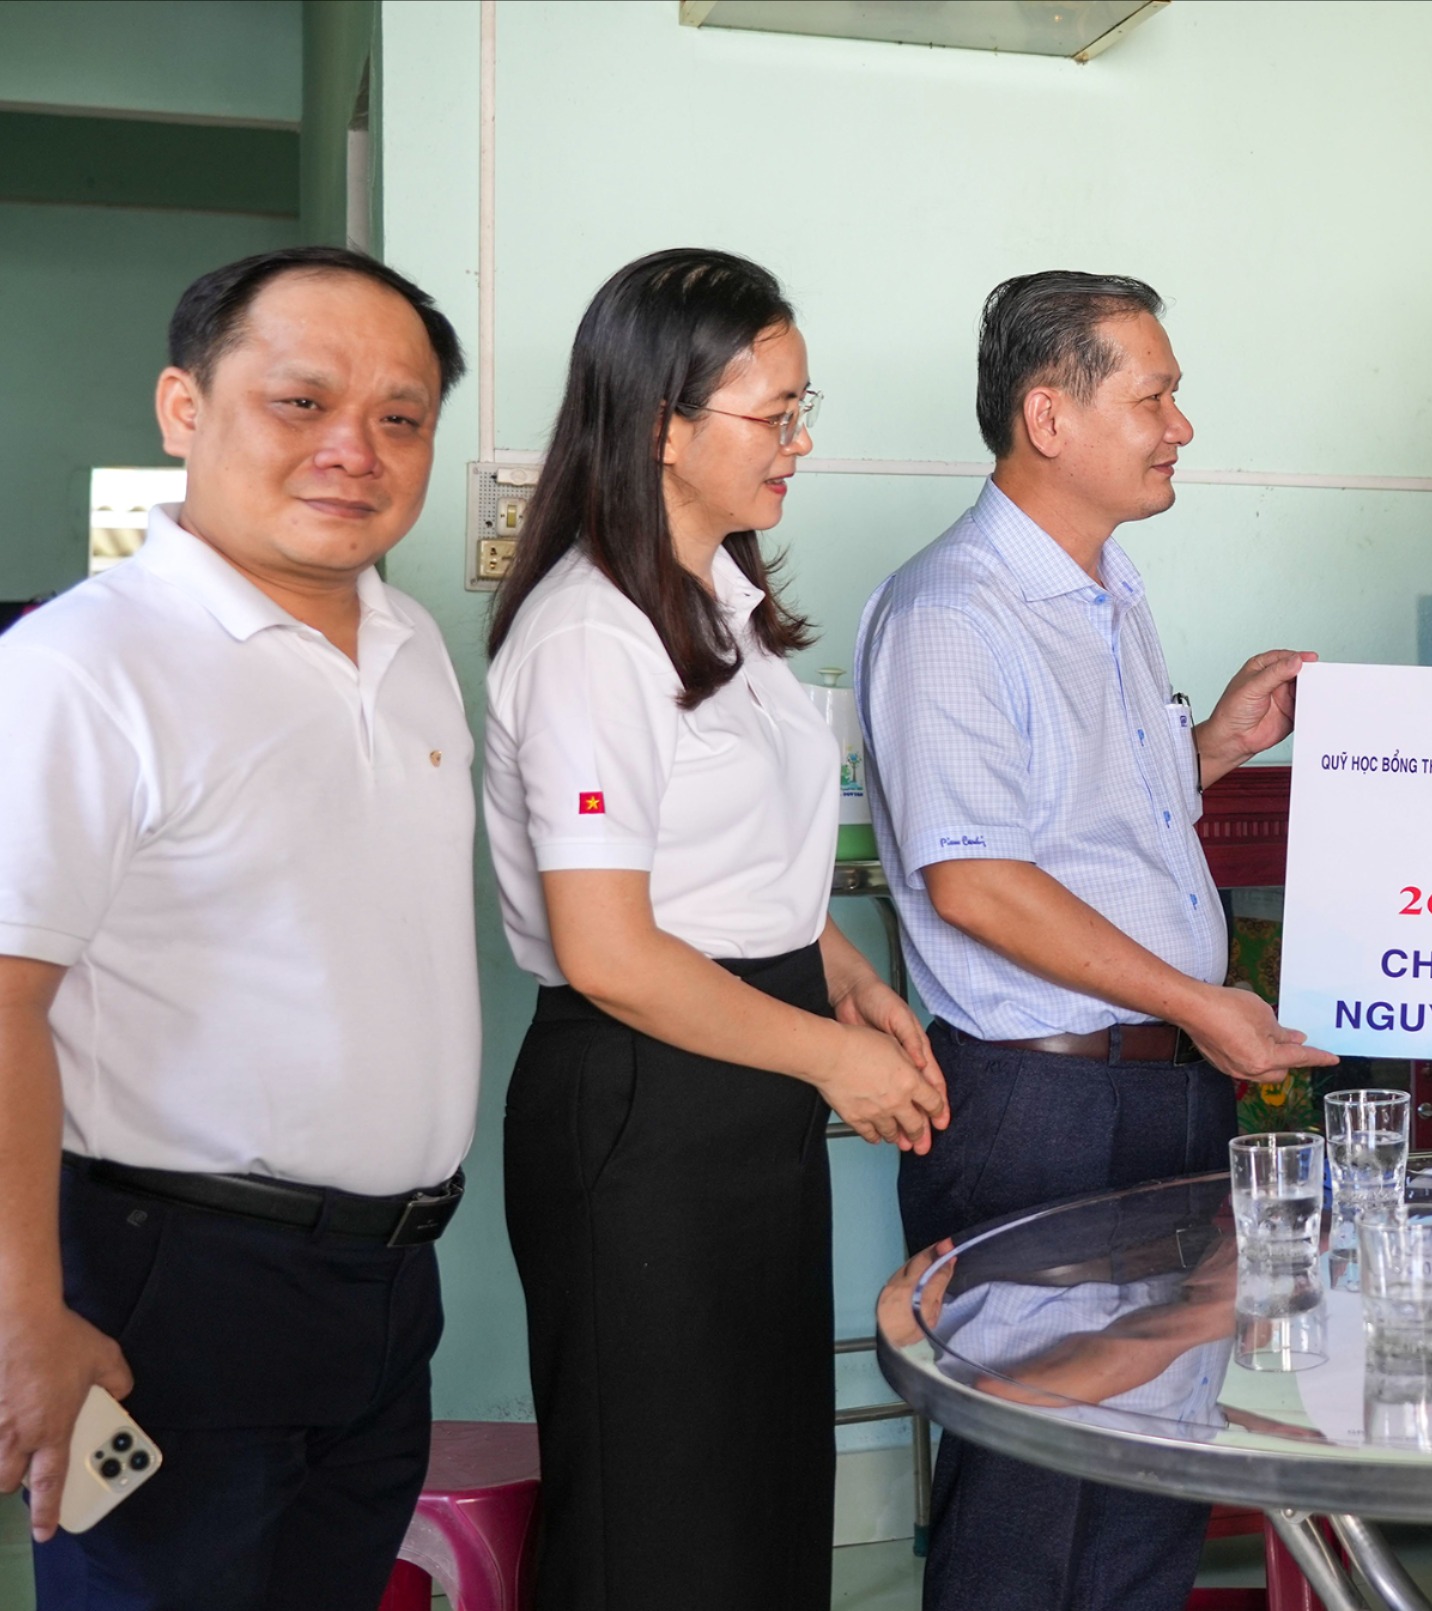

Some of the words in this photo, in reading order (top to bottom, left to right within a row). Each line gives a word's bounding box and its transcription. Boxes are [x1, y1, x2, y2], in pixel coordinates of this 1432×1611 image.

[1321, 753, 1348, 771] QUỸ
[1351, 756, 1379, 775] HỌC
[1381, 749, 1418, 774] BỔNG
